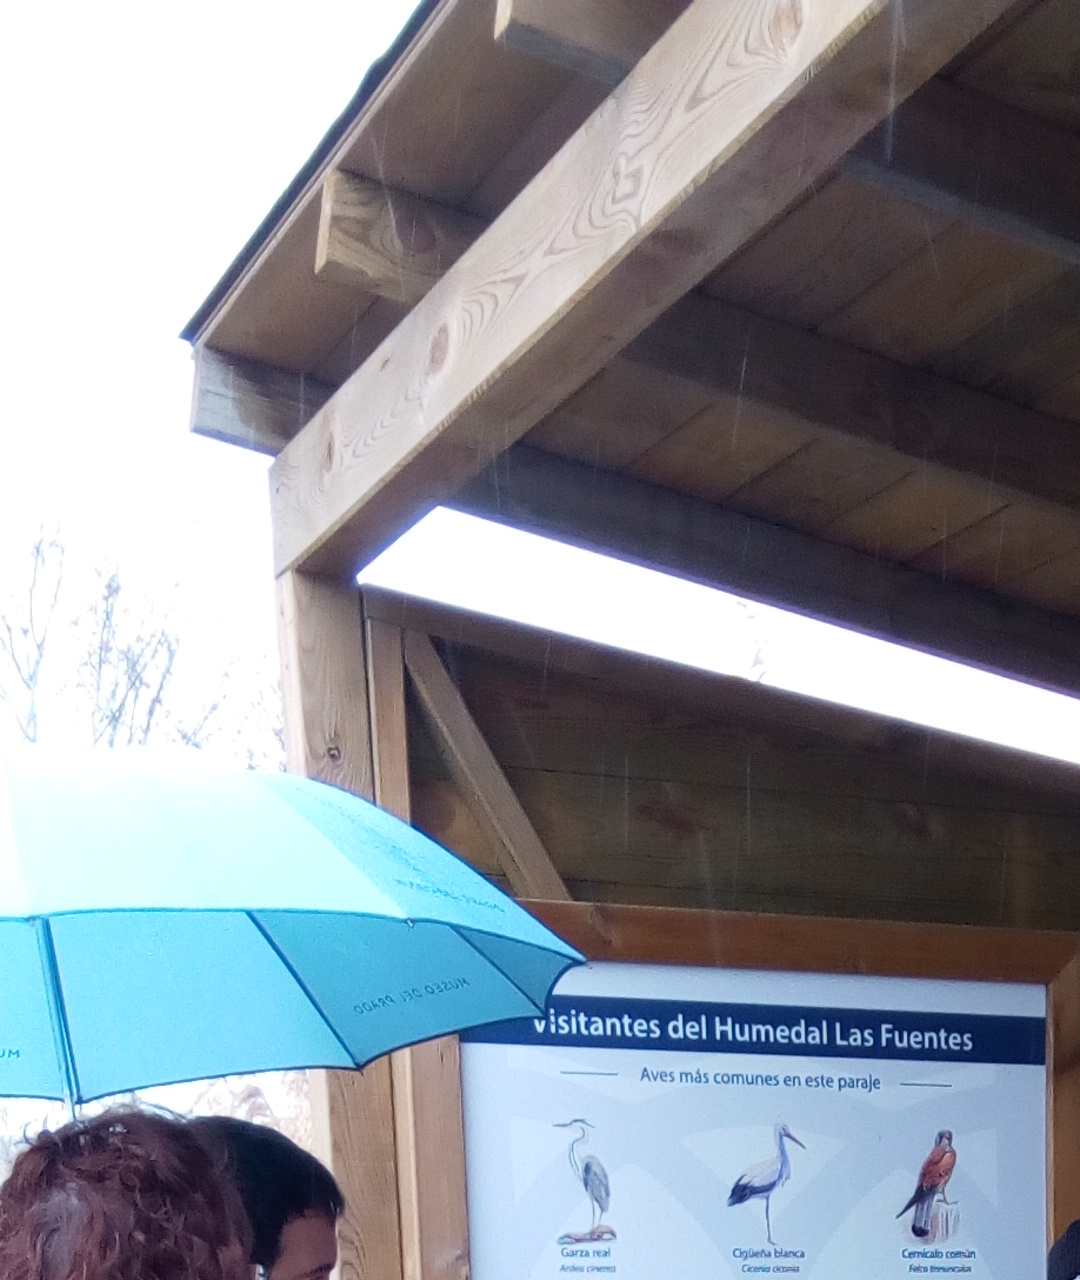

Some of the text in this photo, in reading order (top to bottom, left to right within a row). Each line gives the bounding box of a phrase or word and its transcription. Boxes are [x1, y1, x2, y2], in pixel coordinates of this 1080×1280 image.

[667, 1013, 707, 1040] del
[714, 1016, 828, 1046] Humedal
[835, 1021, 874, 1048] Las
[881, 1023, 974, 1051] Fuentes
[640, 1066, 881, 1093] Aves más comunes en este paraje
[560, 1246, 611, 1258] Garza real
[773, 1247, 806, 1259] blanca
